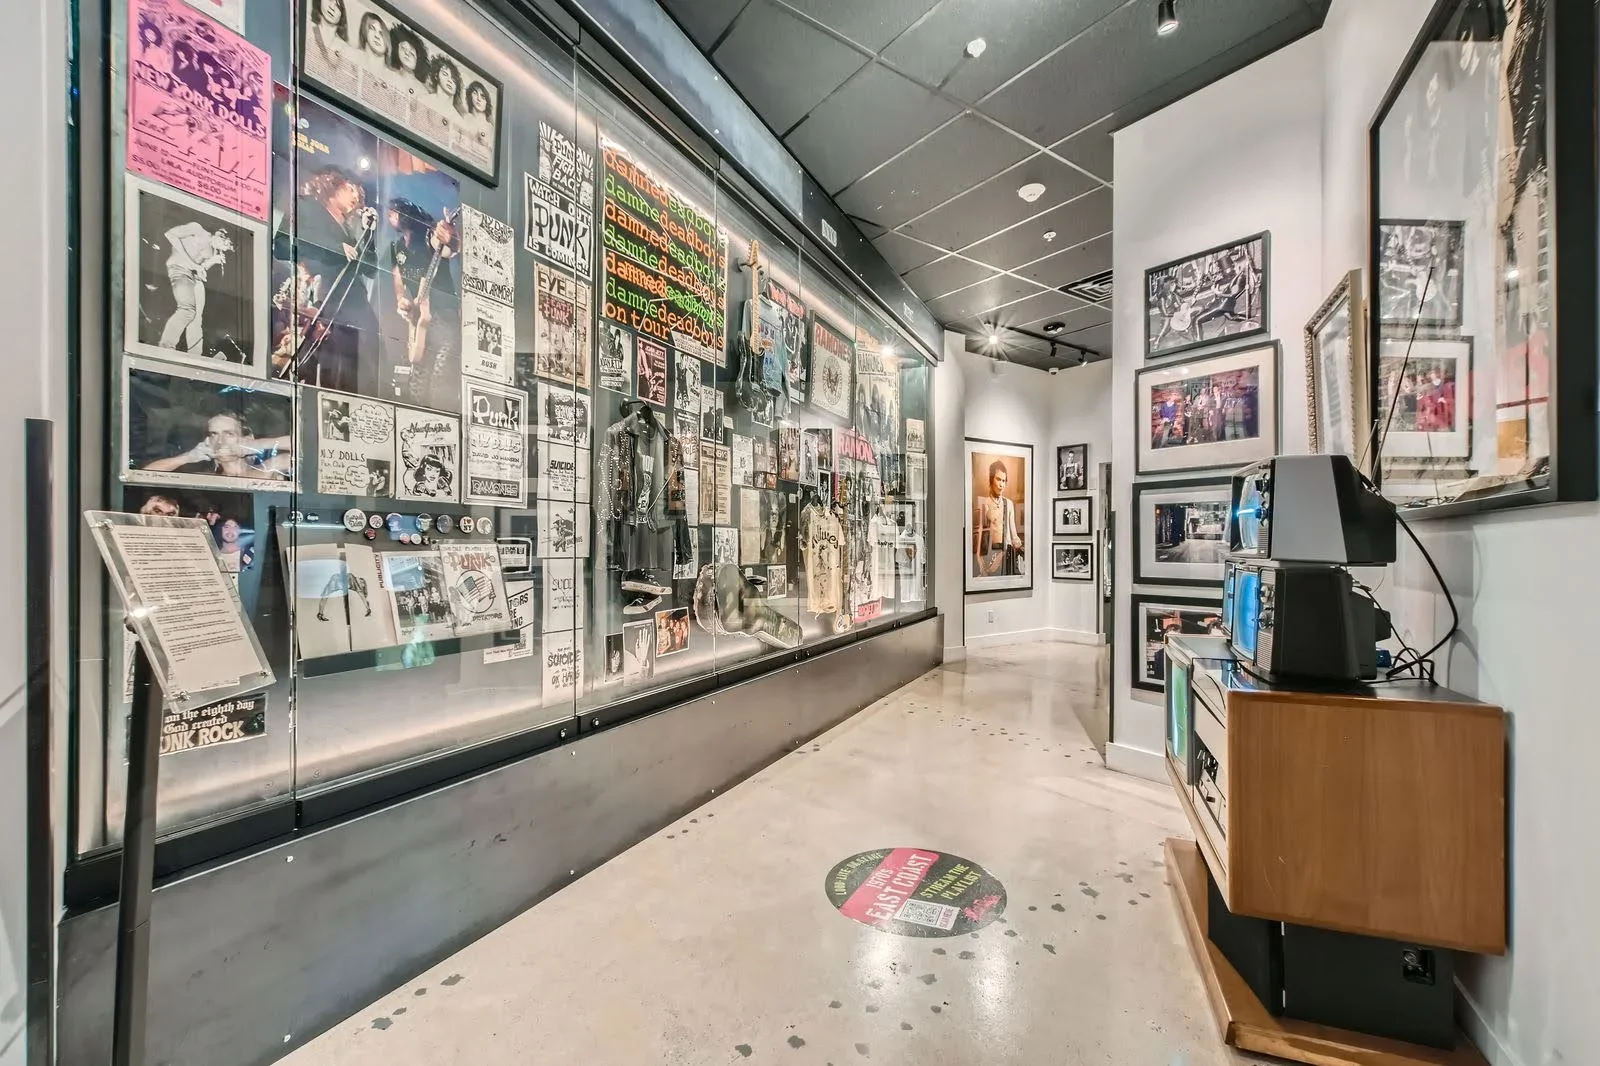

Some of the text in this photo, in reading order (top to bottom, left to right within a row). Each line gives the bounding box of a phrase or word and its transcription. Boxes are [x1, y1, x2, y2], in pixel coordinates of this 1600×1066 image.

[132, 59, 172, 93] NEW
[218, 103, 266, 138] DOLLS
[186, 168, 237, 193] AUDITORIUM
[529, 178, 560, 208] WATCH
[529, 235, 540, 251] IS
[533, 202, 588, 262] PUNK
[605, 302, 670, 340] on tour
[481, 359, 498, 369] RUSH
[472, 396, 519, 431] Punk
[339, 450, 366, 462] DOLLS
[471, 479, 519, 497] RAMONES
[374, 553, 385, 589] PUBLICITY
[447, 551, 492, 572] PUNK
[508, 592, 529, 610] TORS
[163, 714, 228, 735] God created
[182, 710, 200, 722] the
[201, 702, 235, 717] eighth
[236, 700, 255, 711] day
[160, 720, 245, 755] UNK ROCK
[865, 853, 934, 922] EAST COAST
[919, 863, 971, 899] STREAM THE
[940, 870, 982, 901] PLAYLIST
